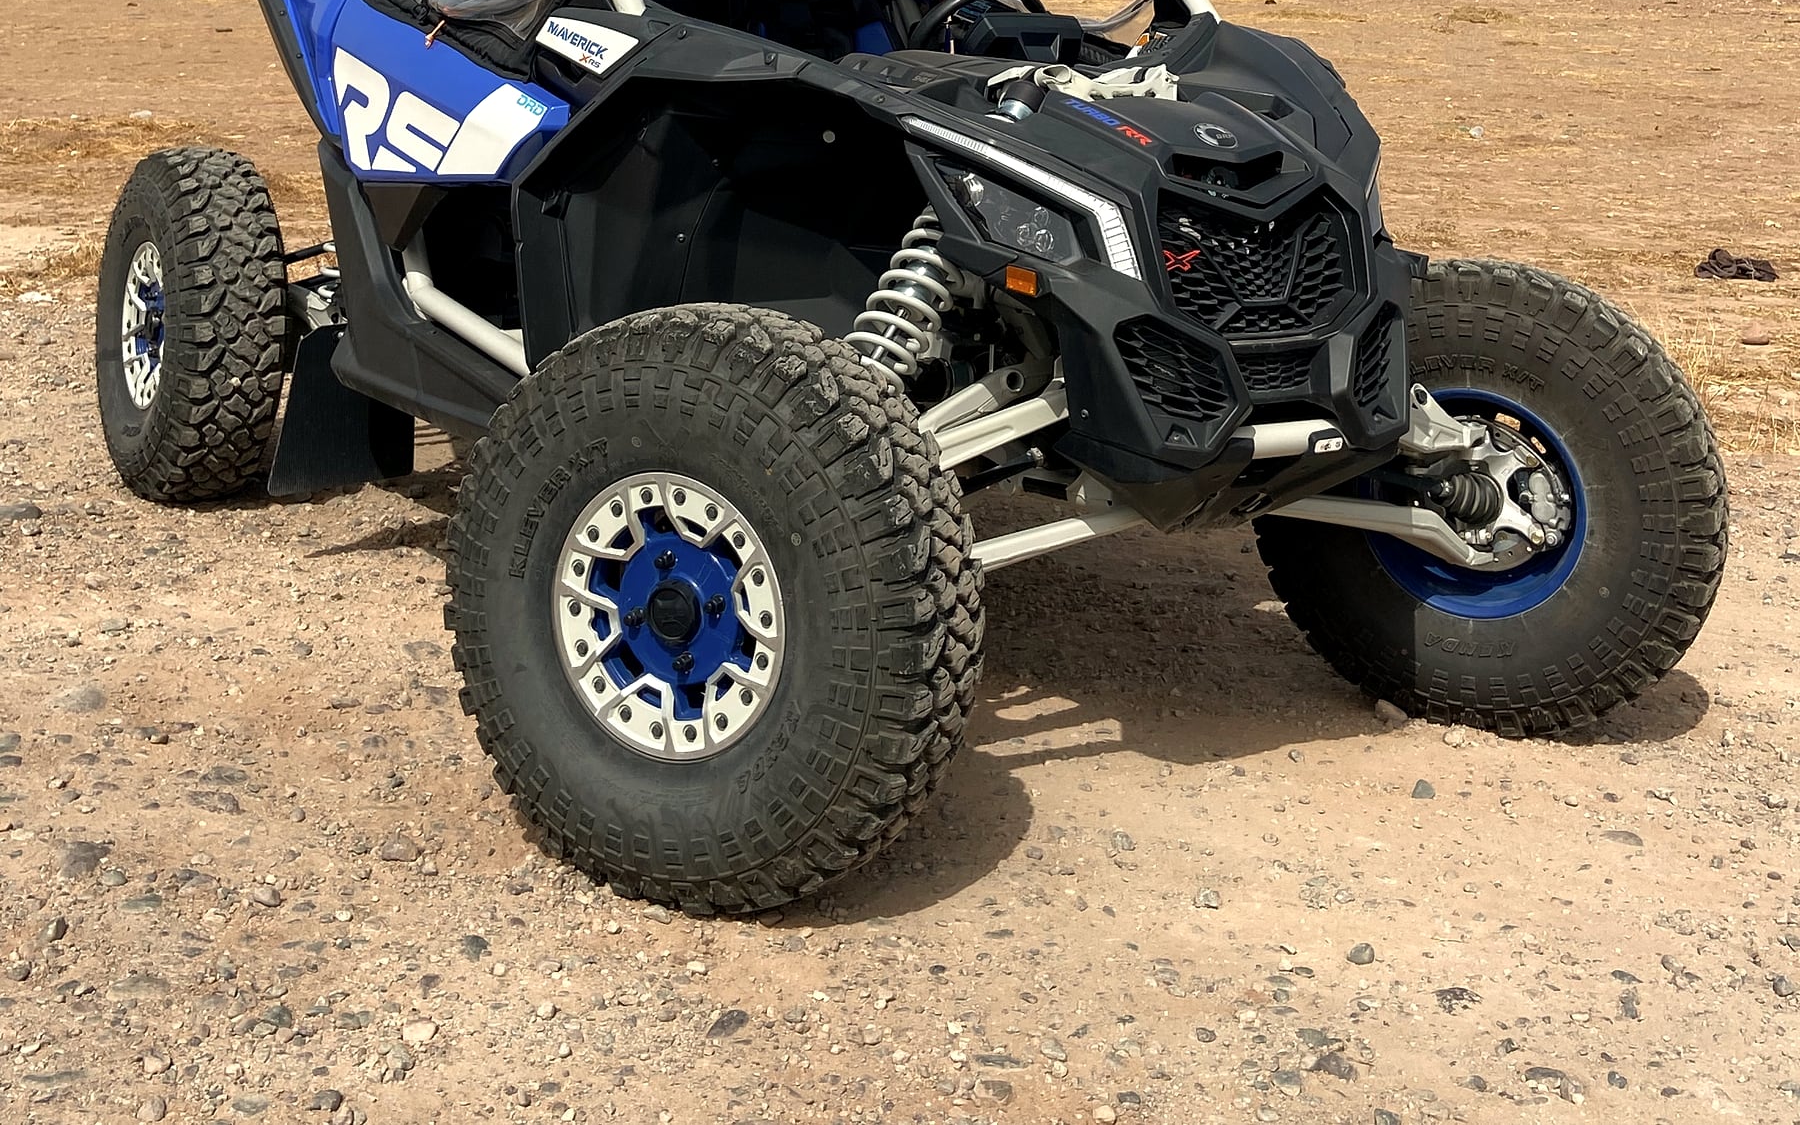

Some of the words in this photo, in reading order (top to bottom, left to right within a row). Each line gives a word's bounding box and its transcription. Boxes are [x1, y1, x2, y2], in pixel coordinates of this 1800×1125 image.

[547, 20, 609, 60] MAVERICK
[516, 94, 545, 116] DRD
[1063, 98, 1121, 127] TURBO
[1115, 125, 1153, 147] RR
[1409, 353, 1496, 377] LEVER
[509, 465, 572, 580] KLEVER
